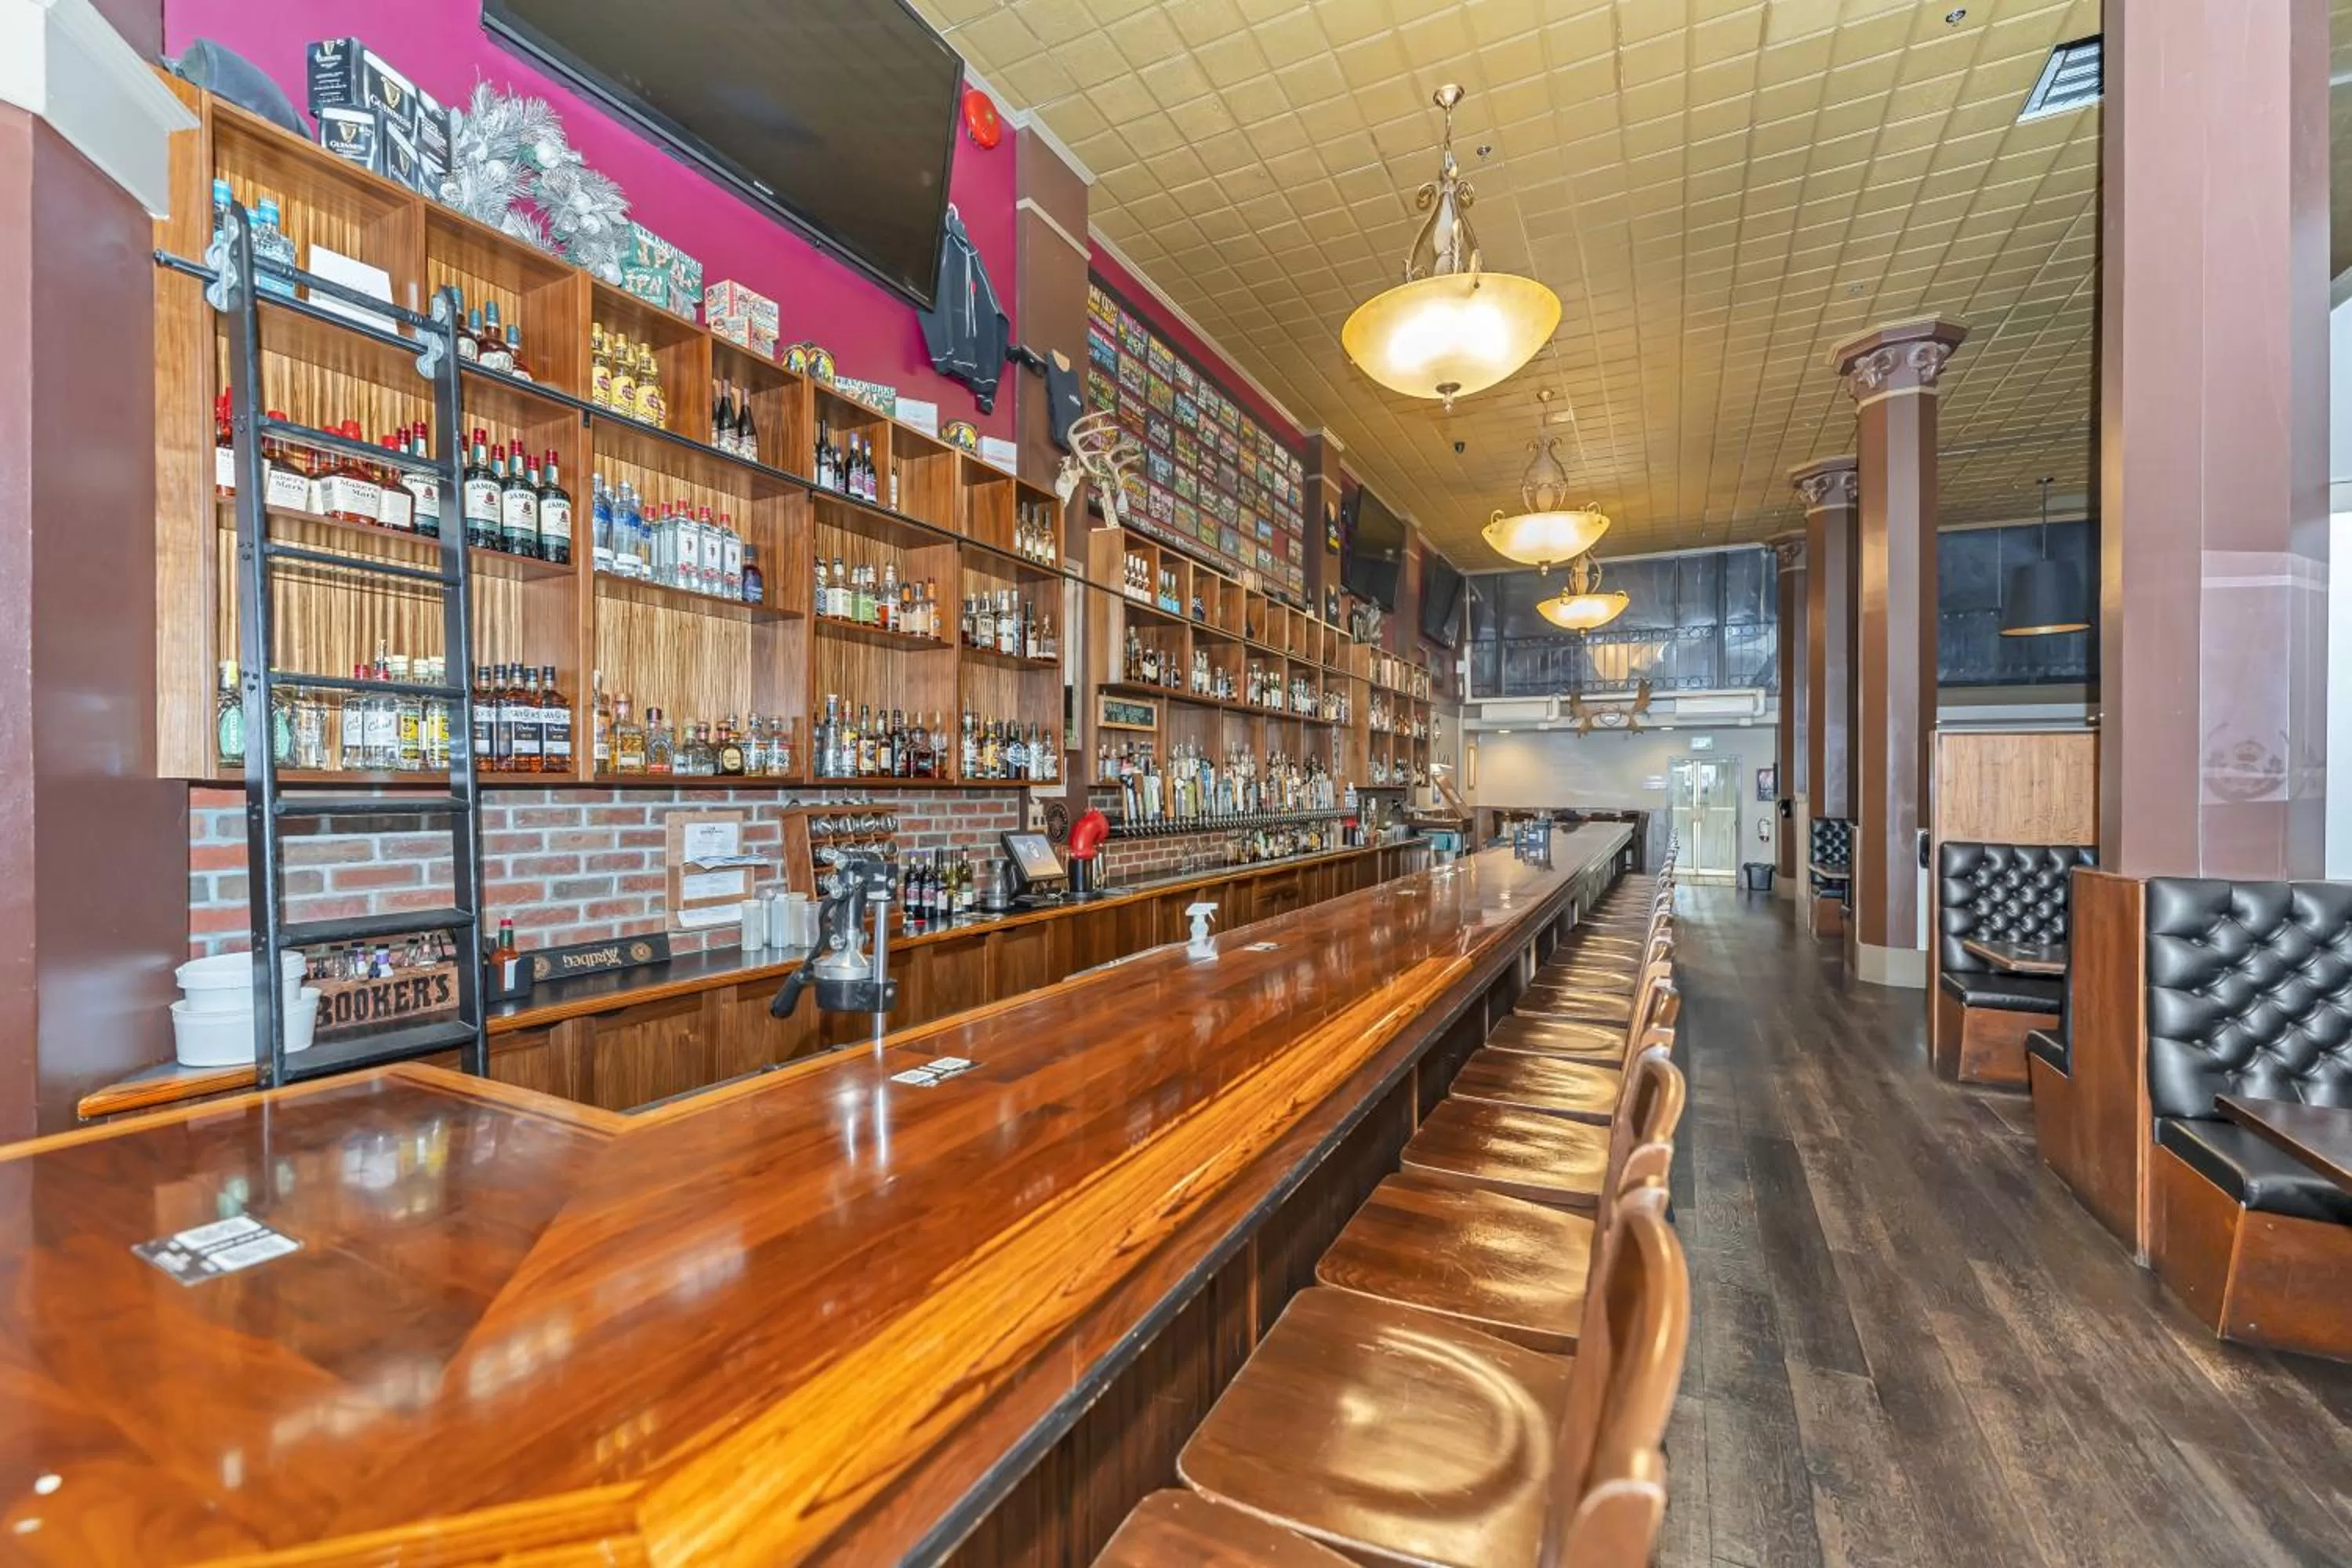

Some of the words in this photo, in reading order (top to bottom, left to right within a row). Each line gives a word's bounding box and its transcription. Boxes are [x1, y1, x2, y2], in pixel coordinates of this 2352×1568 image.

[276, 480, 304, 492] Mark
[353, 488, 377, 499] Mark
[316, 974, 449, 1028] BOOKER'S
